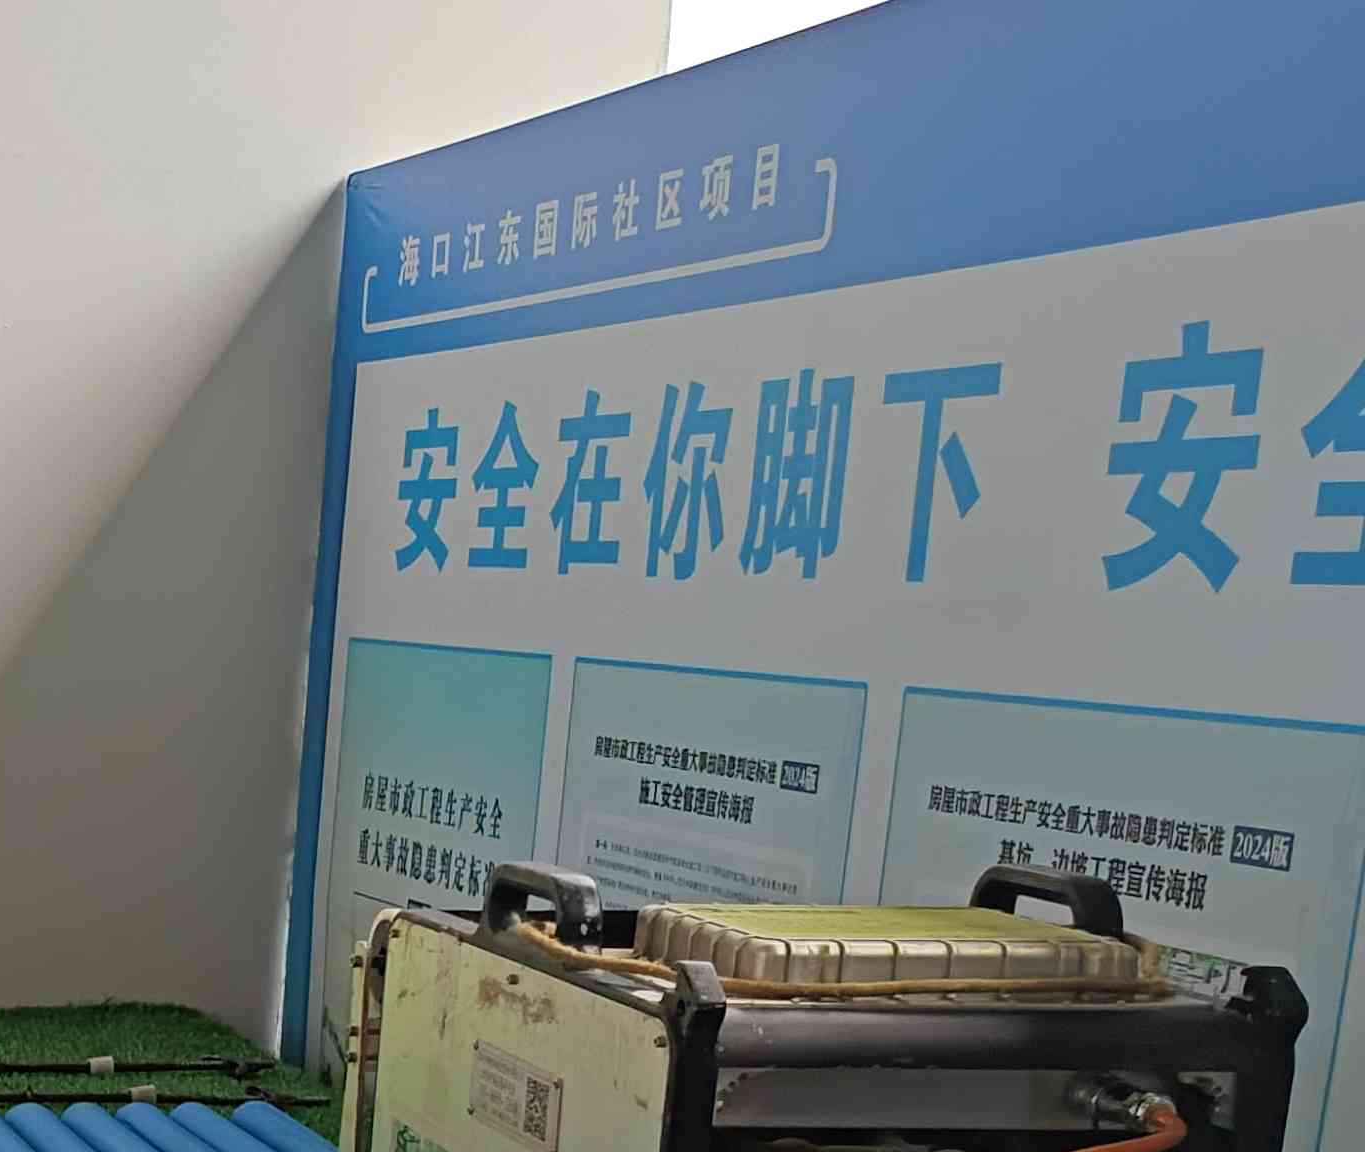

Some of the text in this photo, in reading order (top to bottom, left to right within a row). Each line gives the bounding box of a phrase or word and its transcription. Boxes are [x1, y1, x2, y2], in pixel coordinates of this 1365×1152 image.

[397, 143, 782, 288] 海口江东国际社区项目
[394, 361, 1004, 583] 安全在你脚下
[361, 771, 503, 840] 房屋市政工程生产安全
[929, 784, 1292, 869] 房屋市政工程生产安全重大事故隐患判定标准 2024版
[997, 838, 1208, 912] 基坑边坡工程宣传海报
